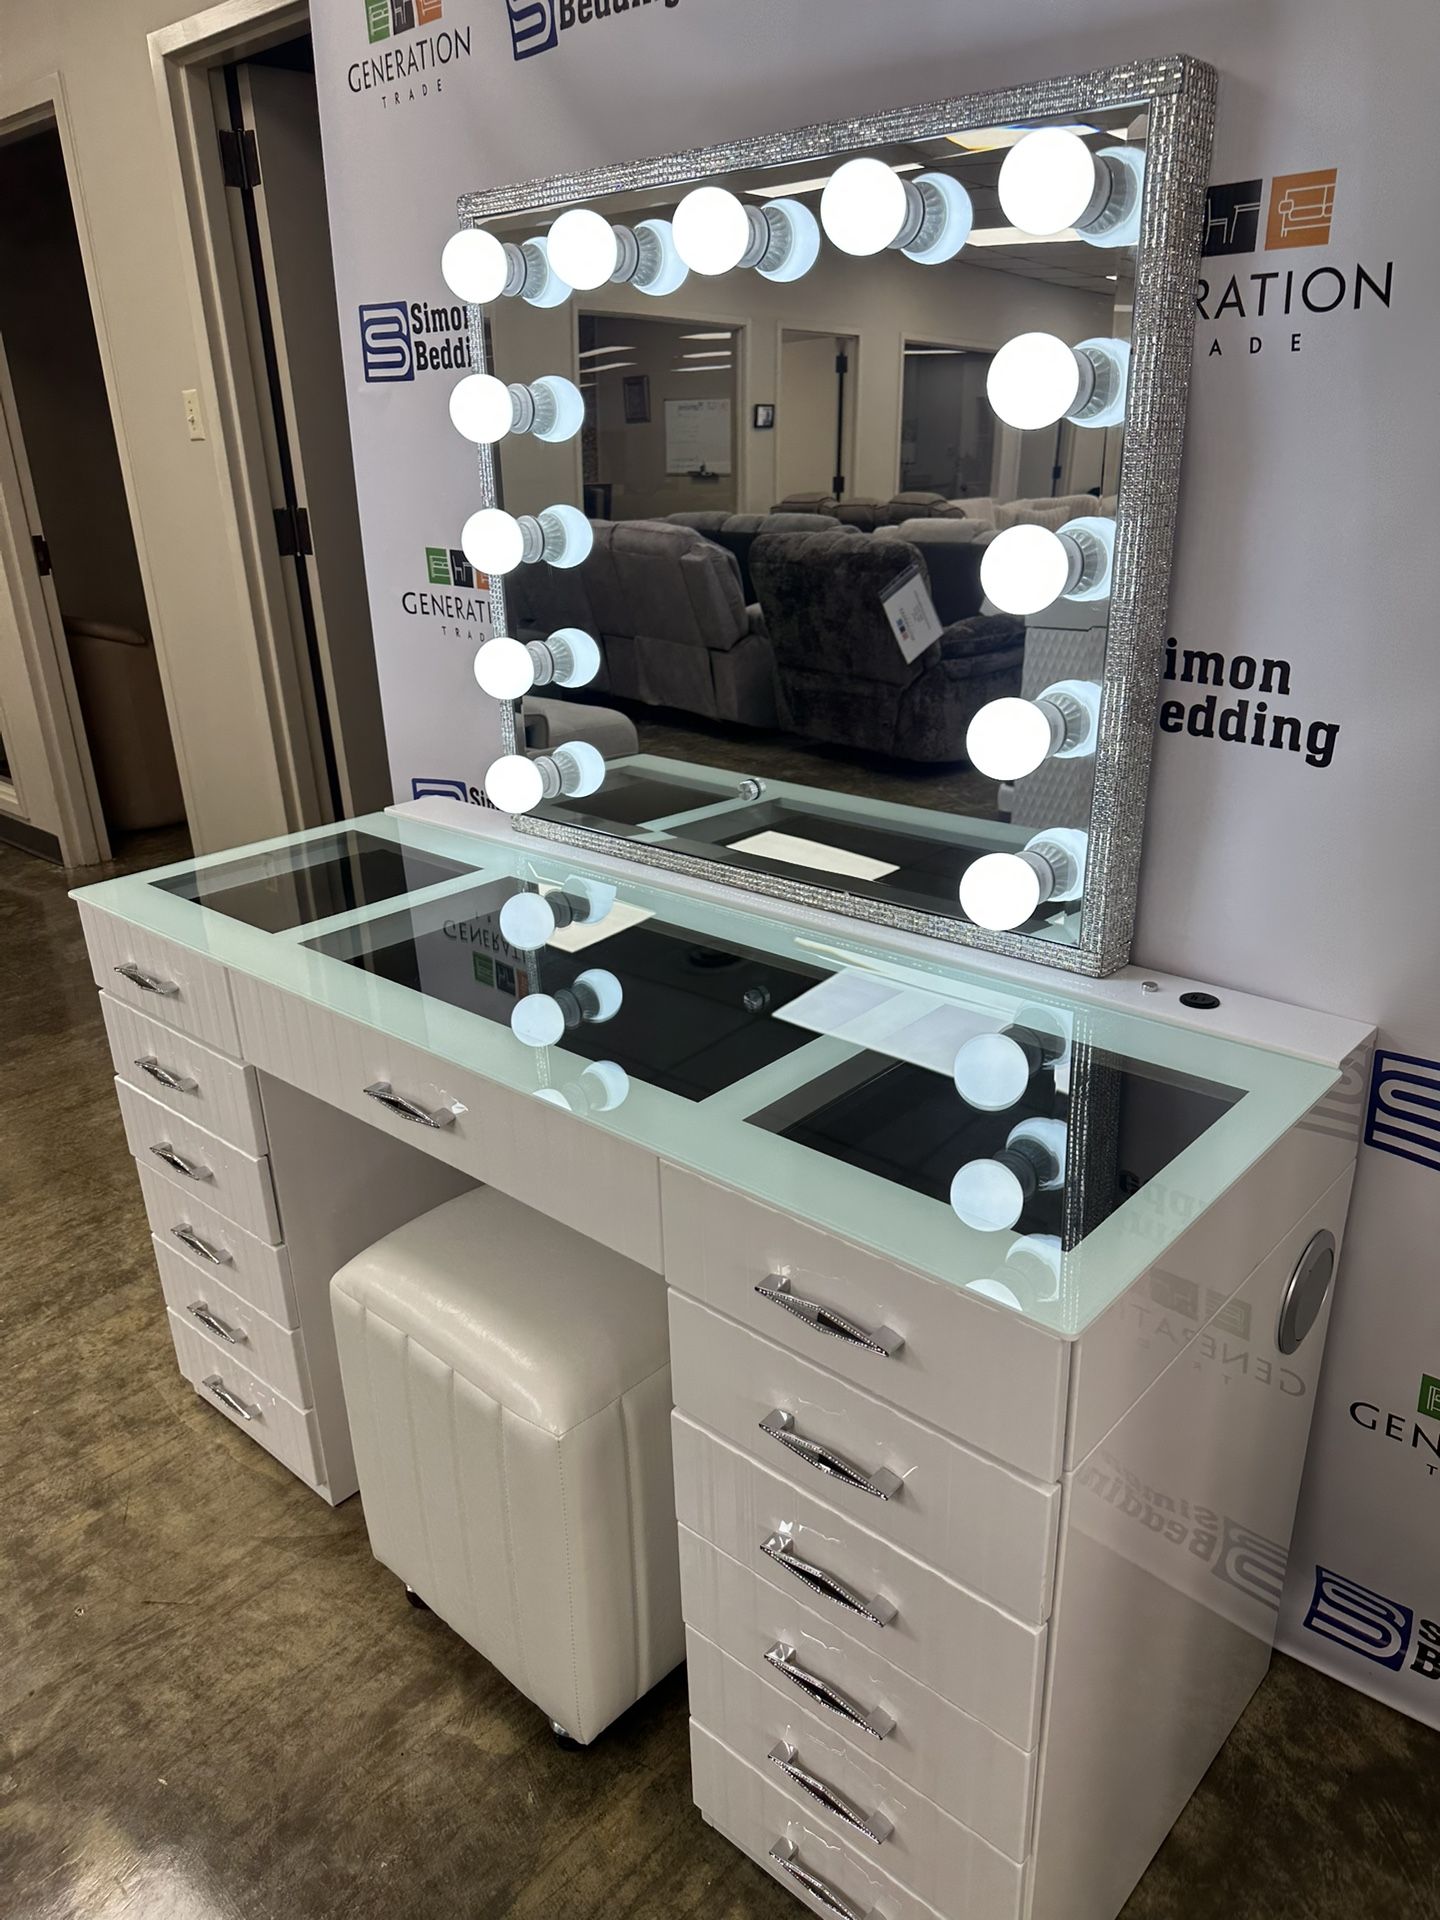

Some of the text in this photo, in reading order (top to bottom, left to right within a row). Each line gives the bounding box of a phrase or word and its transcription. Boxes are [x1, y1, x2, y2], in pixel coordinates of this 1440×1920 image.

[348, 25, 471, 93] GENERATION
[381, 78, 442, 109] TRADE
[1208, 333, 1302, 357] ADE
[1163, 637, 1292, 695] imon
[1159, 695, 1341, 768] edding
